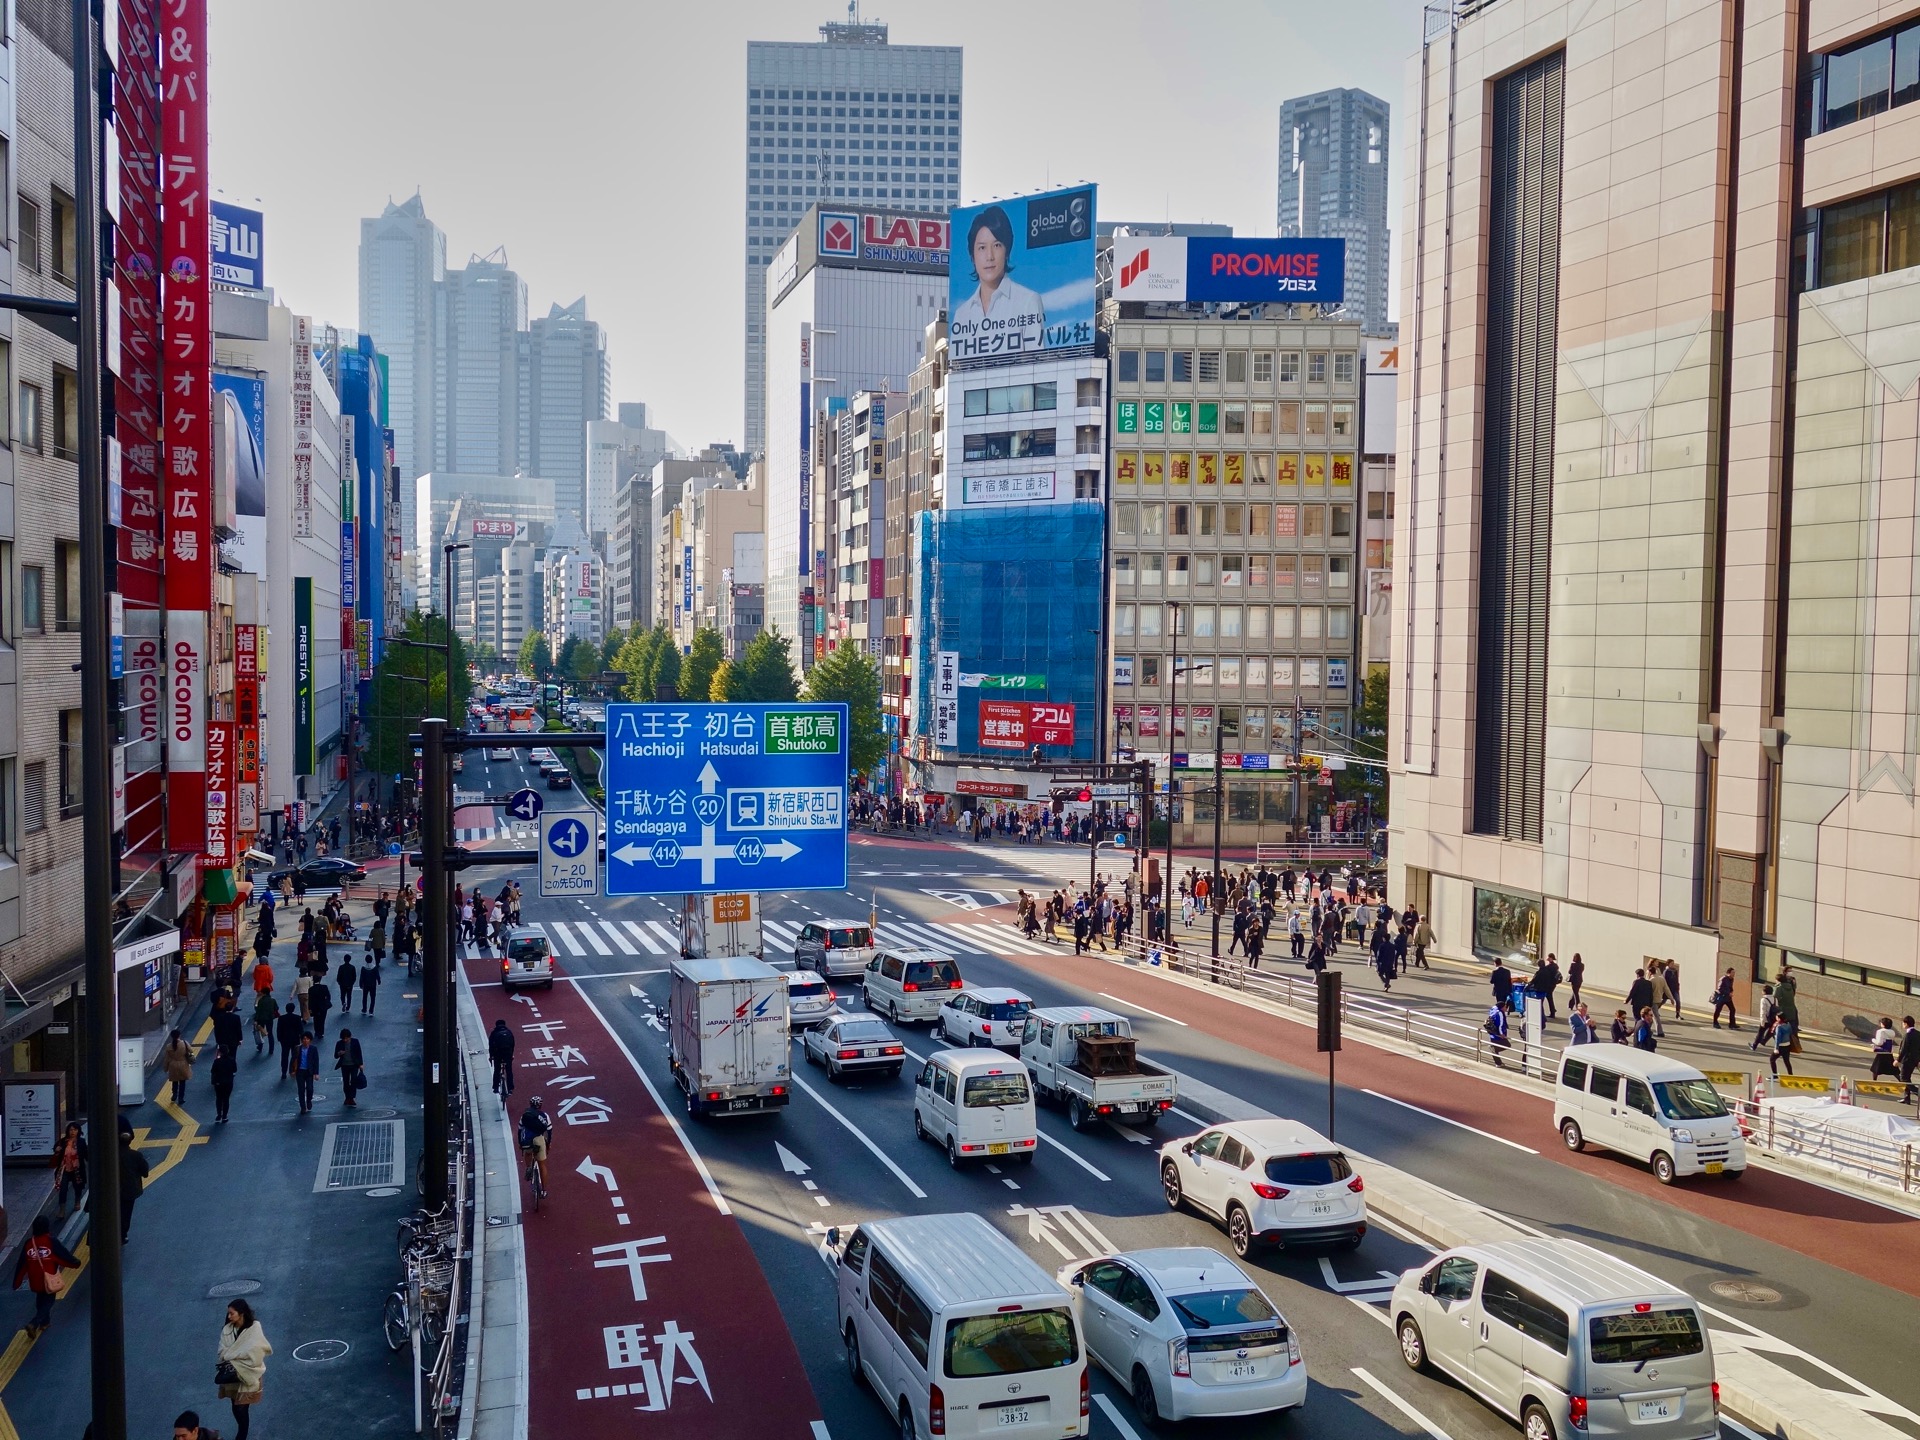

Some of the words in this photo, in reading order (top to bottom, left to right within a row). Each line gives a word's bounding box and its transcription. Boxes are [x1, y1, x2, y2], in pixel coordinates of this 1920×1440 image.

[1031, 209, 1067, 237] global
[864, 247, 925, 263] SHINJUKU
[930, 252, 950, 265] 西口
[1211, 253, 1320, 277] PROMISE
[1278, 278, 1317, 292] プロミス
[951, 321, 979, 337] Only
[980, 317, 1006, 332] One
[1007, 312, 1047, 328] の住まい
[952, 322, 1091, 357] THEグローバル社
[294, 372, 311, 381] 共立
[294, 382, 311, 392] 美容
[252, 382, 262, 447] 白き華、ひらく。
[172, 294, 198, 562] カラオケ歌広場
[294, 454, 311, 462] KEN
[1117, 458, 1190, 480] 占い館
[1278, 460, 1351, 481] 占い館
[972, 476, 1049, 493] 新宿矯正歯科
[801, 496, 809, 511] For
[476, 521, 512, 533] やまや
[343, 536, 352, 560] JAPAN
[343, 562, 352, 583] TOTAL
[343, 584, 352, 604] CLUB
[237, 632, 255, 673] 指圧
[299, 625, 309, 682] PRESTÍA
[942, 656, 953, 694] 工事中
[1000, 675, 1027, 688] レイク
[1328, 675, 1345, 683] 営業所
[175, 641, 192, 742] docomo
[948, 702, 956, 721] 全館
[1032, 707, 1071, 724] アコム
[615, 712, 692, 738] 八王子
[703, 711, 756, 738] 初台
[768, 715, 836, 738] 首都高
[938, 706, 948, 743] 営業中
[983, 719, 1025, 738] 営業中
[777, 738, 827, 751] Shutoko
[1044, 730, 1058, 742] 6F
[207, 727, 226, 791] カラオケ
[622, 742, 685, 759] Hachioji
[700, 741, 759, 756] Hatsudai
[958, 783, 979, 791] ファースト
[698, 800, 719, 816] 20
[767, 791, 839, 813] 新宿駅西口
[614, 820, 687, 836] Sendagaya
[768, 814, 808, 828] Shinjuku
[810, 813, 839, 826] Sta.-W.
[207, 807, 226, 858] 歌広場
[655, 847, 677, 861] 414
[738, 844, 761, 858] 414
[544, 877, 593, 889] この先50m
[719, 900, 736, 909] ECO
[719, 909, 745, 918] BUDDY
[137, 948, 148, 958] SUIT
[148, 942, 164, 954] SELECT
[1233, 1365, 1256, 1377] 47-18
[1004, 1411, 1029, 1424] 38-32
